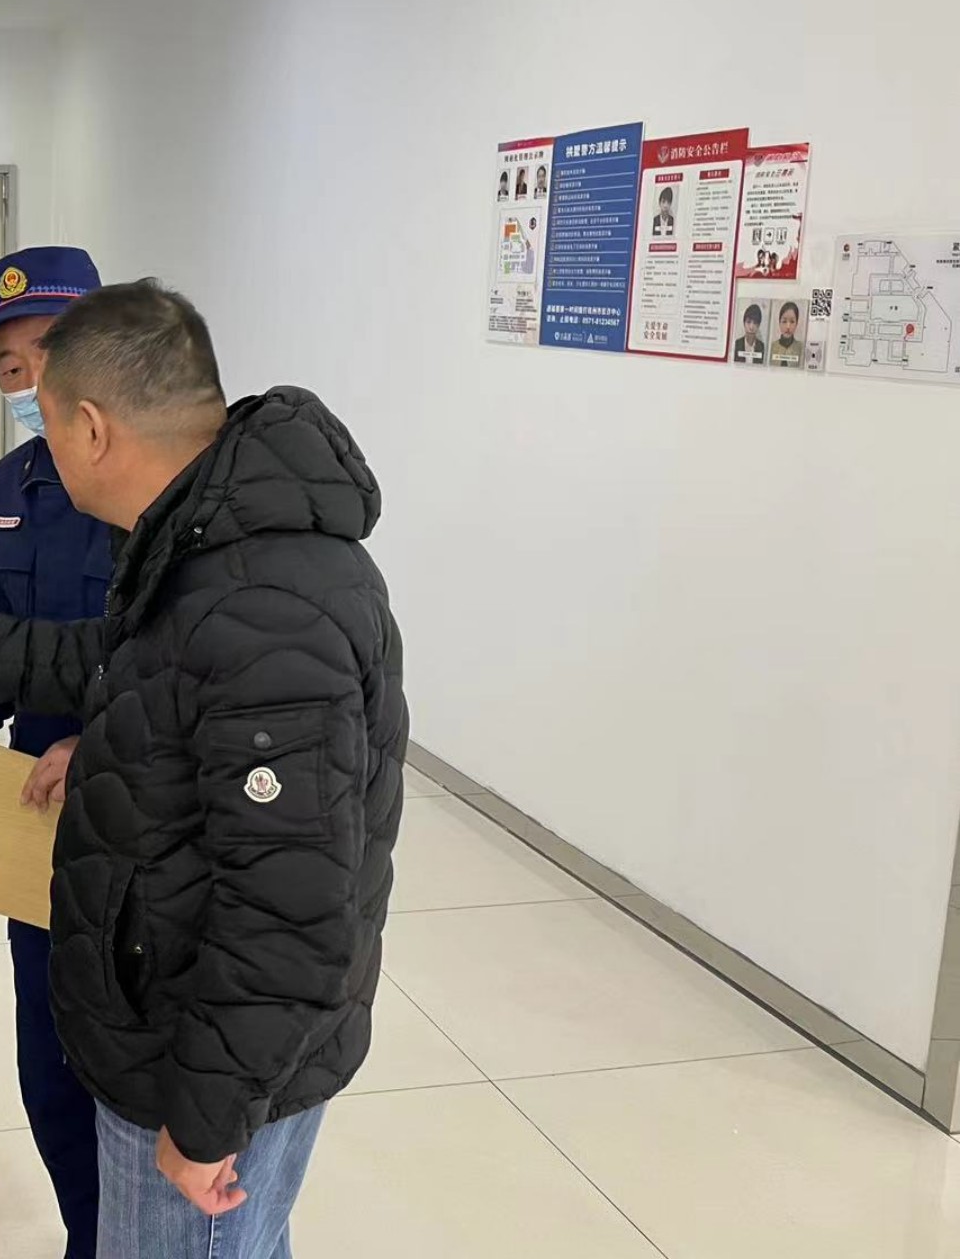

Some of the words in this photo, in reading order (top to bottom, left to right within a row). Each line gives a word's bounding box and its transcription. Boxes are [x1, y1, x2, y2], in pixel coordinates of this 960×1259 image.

[670, 141, 729, 161] 消防安全公告栏
